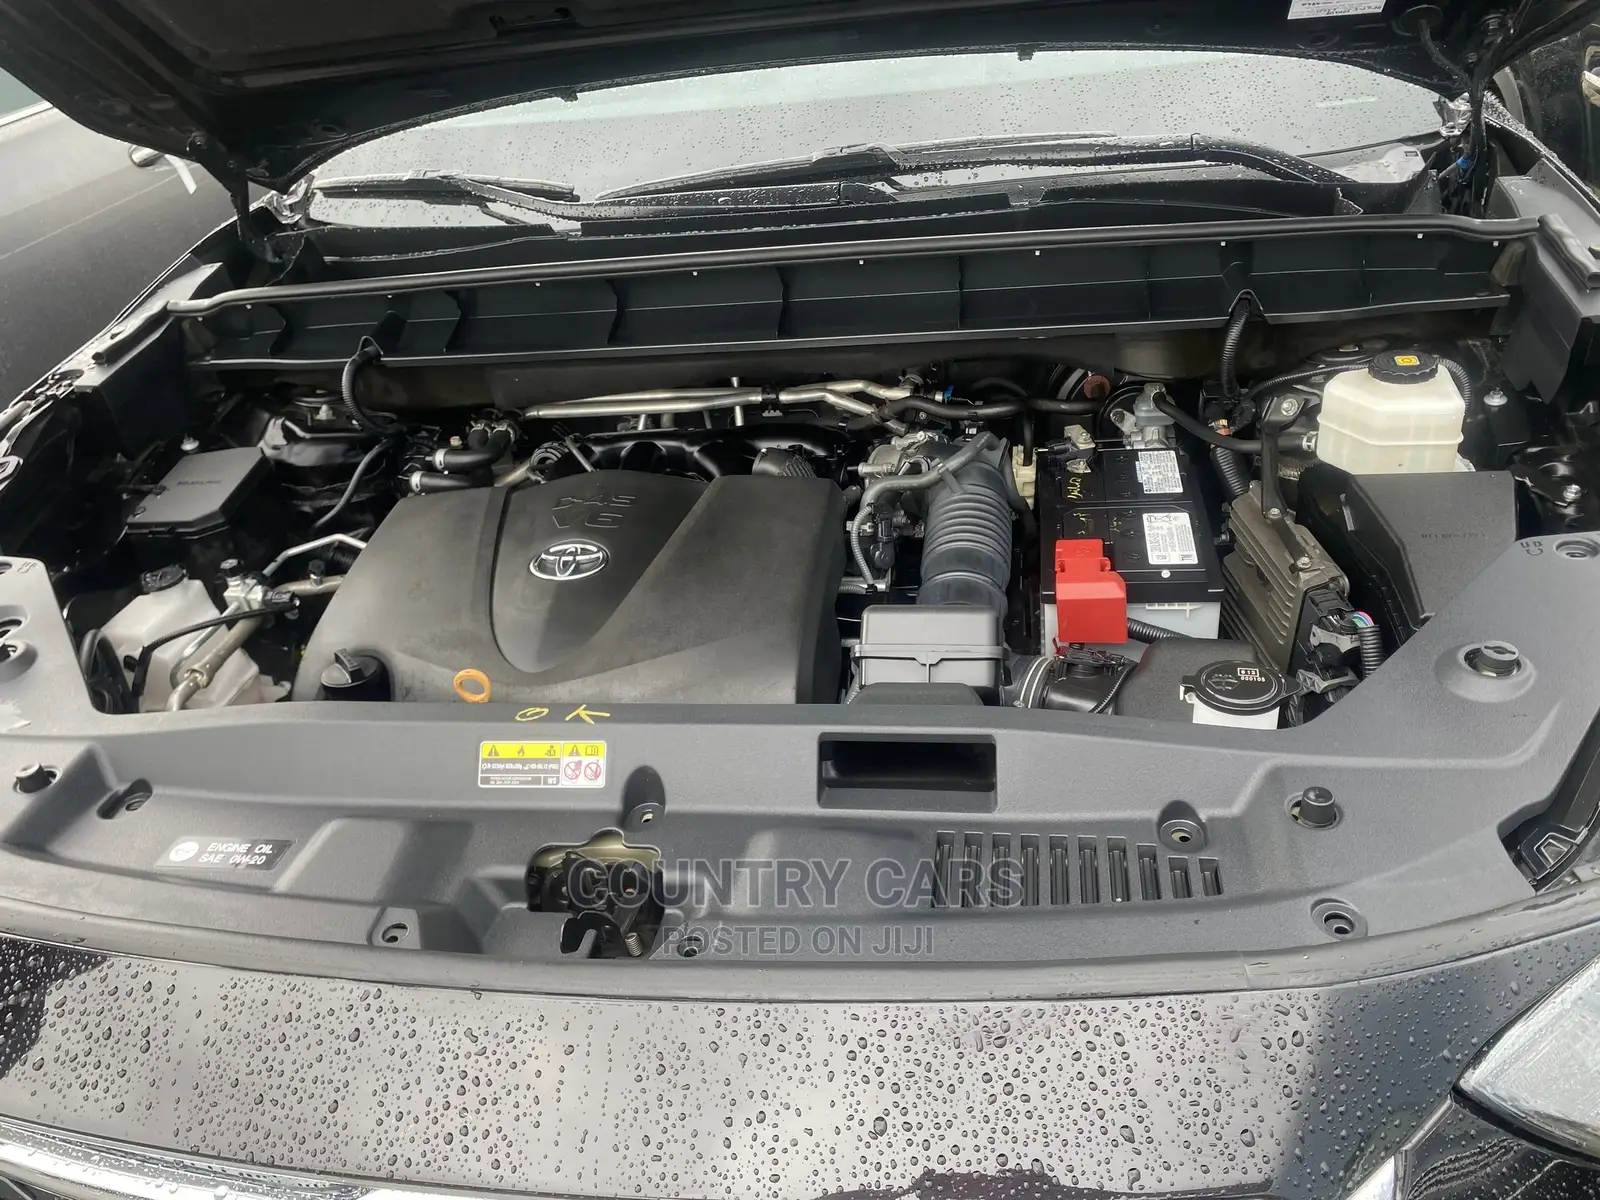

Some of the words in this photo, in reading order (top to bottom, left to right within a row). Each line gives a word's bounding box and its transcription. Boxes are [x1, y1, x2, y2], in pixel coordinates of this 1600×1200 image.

[206, 842, 251, 853] ENGINE
[254, 843, 273, 854] OIL
[198, 853, 225, 863] SAE
[228, 855, 267, 865] 0W-20
